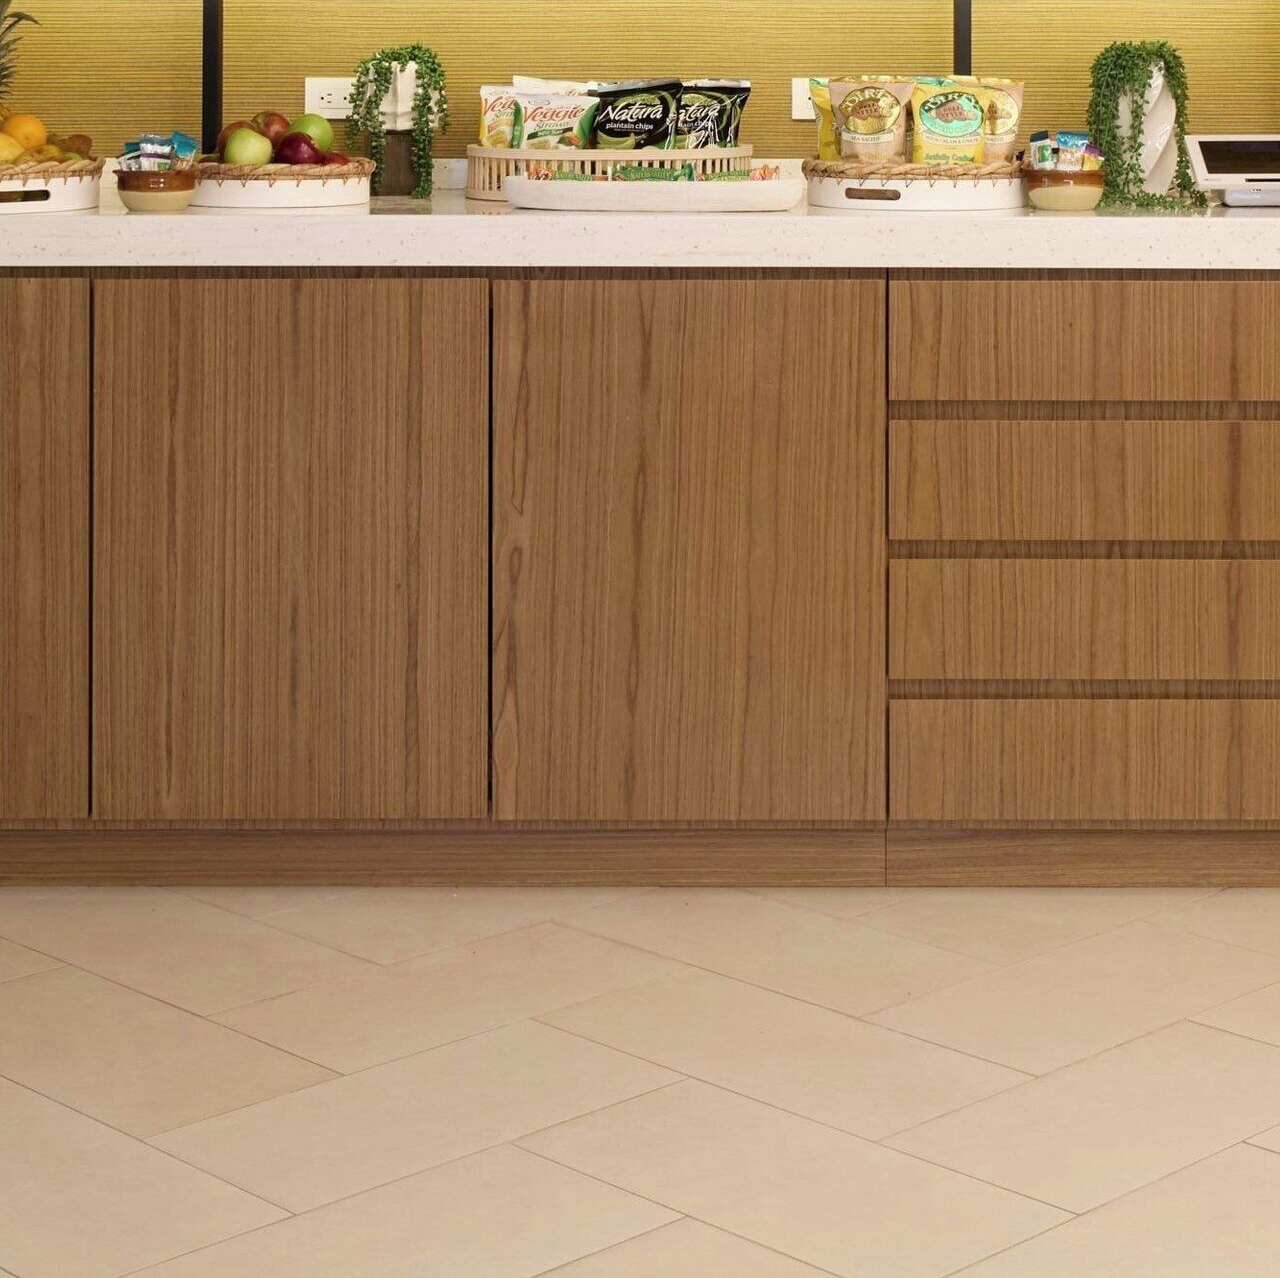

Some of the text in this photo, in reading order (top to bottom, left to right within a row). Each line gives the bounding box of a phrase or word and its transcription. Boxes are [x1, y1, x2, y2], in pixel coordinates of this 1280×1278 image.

[523, 104, 586, 123] Veggie
[599, 102, 663, 122] Natura
[678, 102, 721, 122] atura
[606, 122, 654, 131] plantain chips
